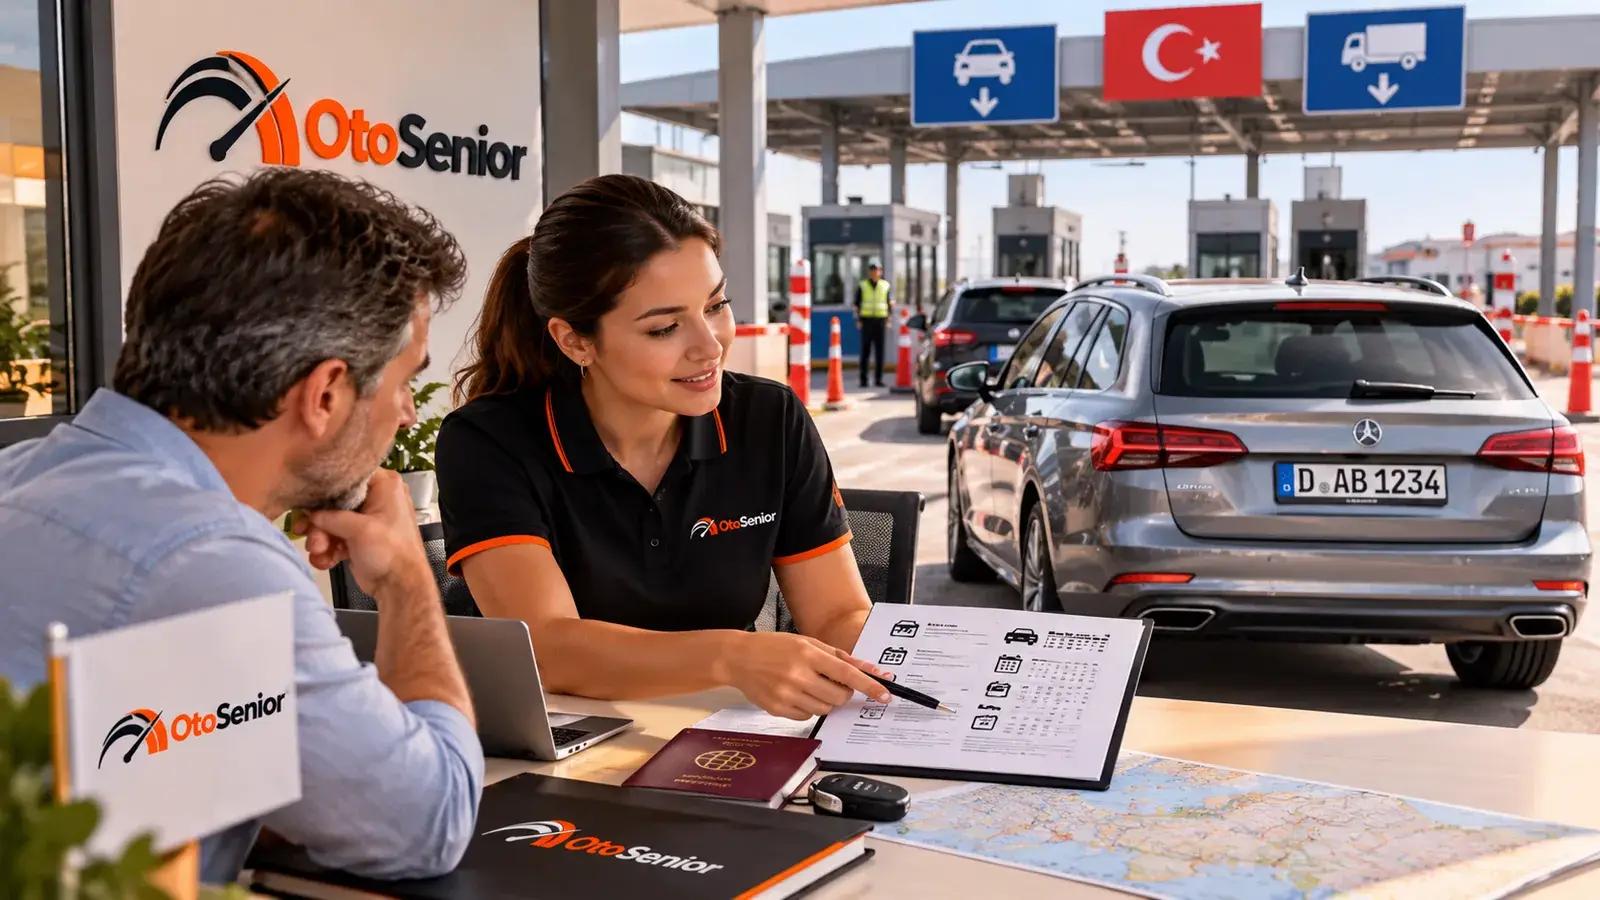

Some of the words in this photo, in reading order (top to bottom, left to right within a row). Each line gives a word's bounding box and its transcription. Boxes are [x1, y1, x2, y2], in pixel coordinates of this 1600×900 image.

[304, 98, 528, 181] OtoSenior
[1298, 468, 1315, 493] D
[1333, 468, 1368, 493] AB
[1374, 469, 1441, 495] 1234
[718, 512, 777, 532] OtoSenior
[170, 692, 286, 742] OtoSenior
[564, 835, 724, 875] OtoSenior
